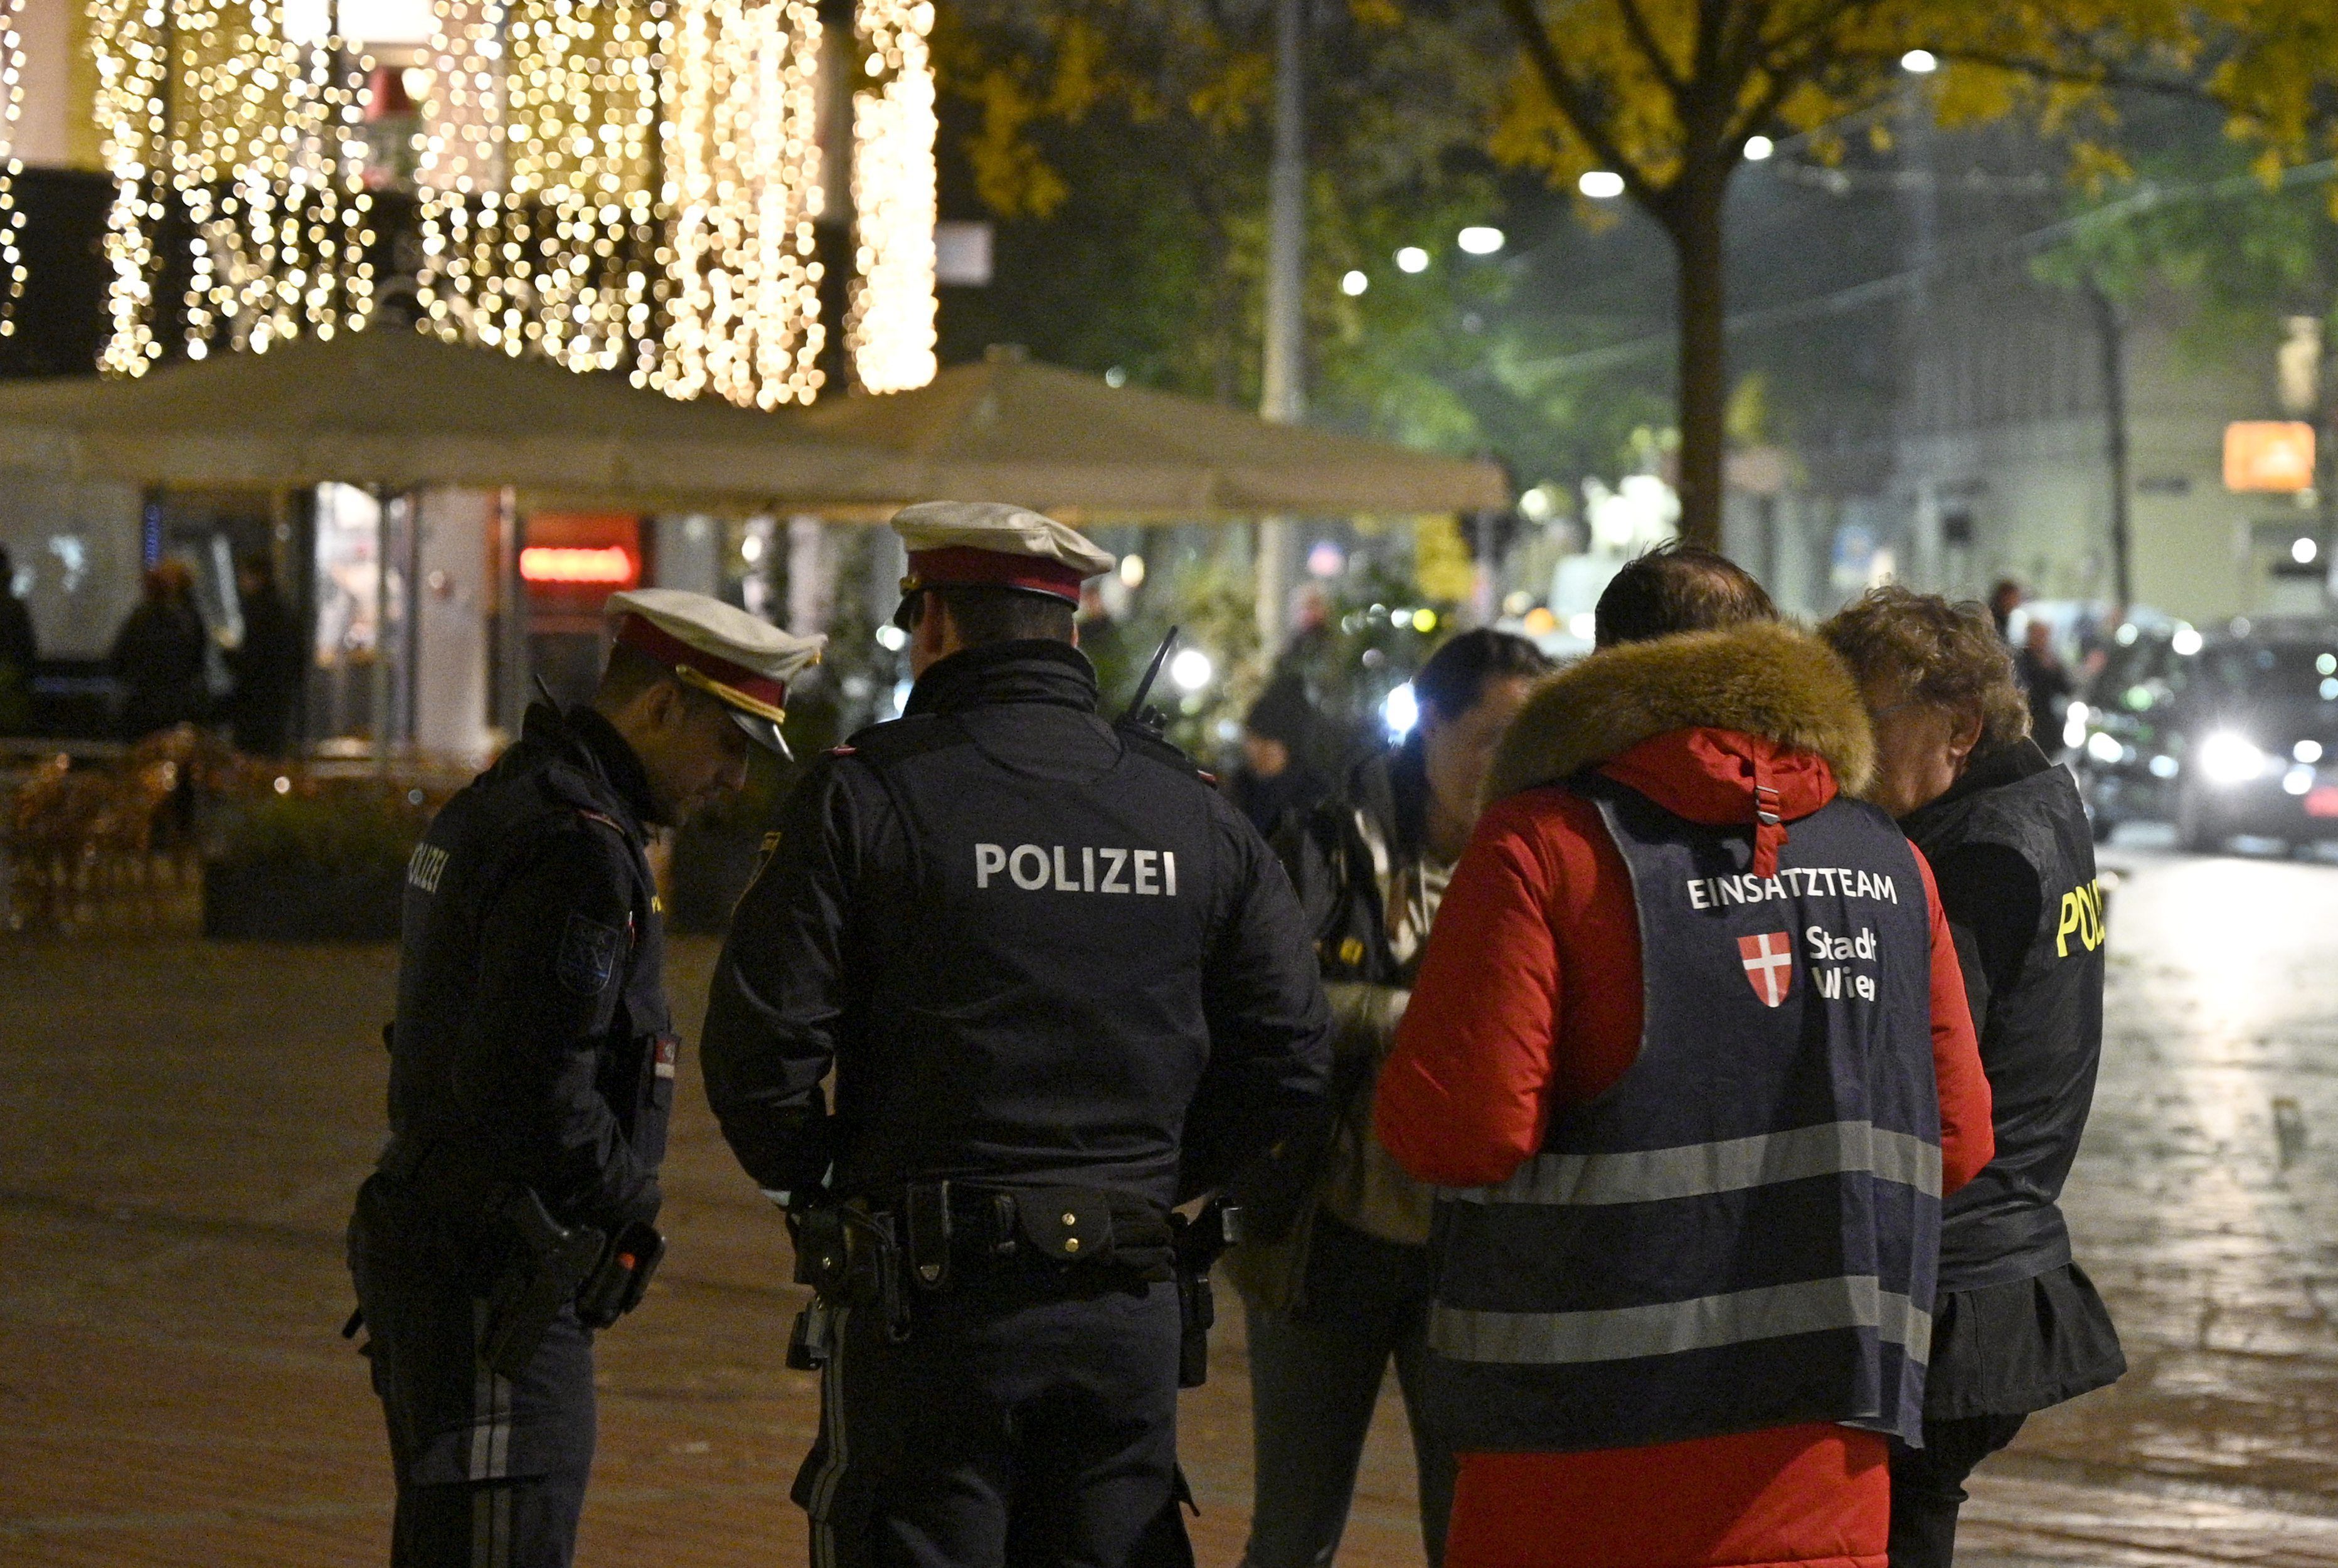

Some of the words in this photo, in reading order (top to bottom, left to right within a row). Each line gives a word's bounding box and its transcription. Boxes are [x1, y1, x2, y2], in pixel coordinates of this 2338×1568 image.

[408, 842, 450, 894] OLIZEI
[975, 843, 1176, 896] POLIZEI
[1687, 868, 1898, 909] EINSATZTEAM
[1805, 926, 1877, 962] Stadt
